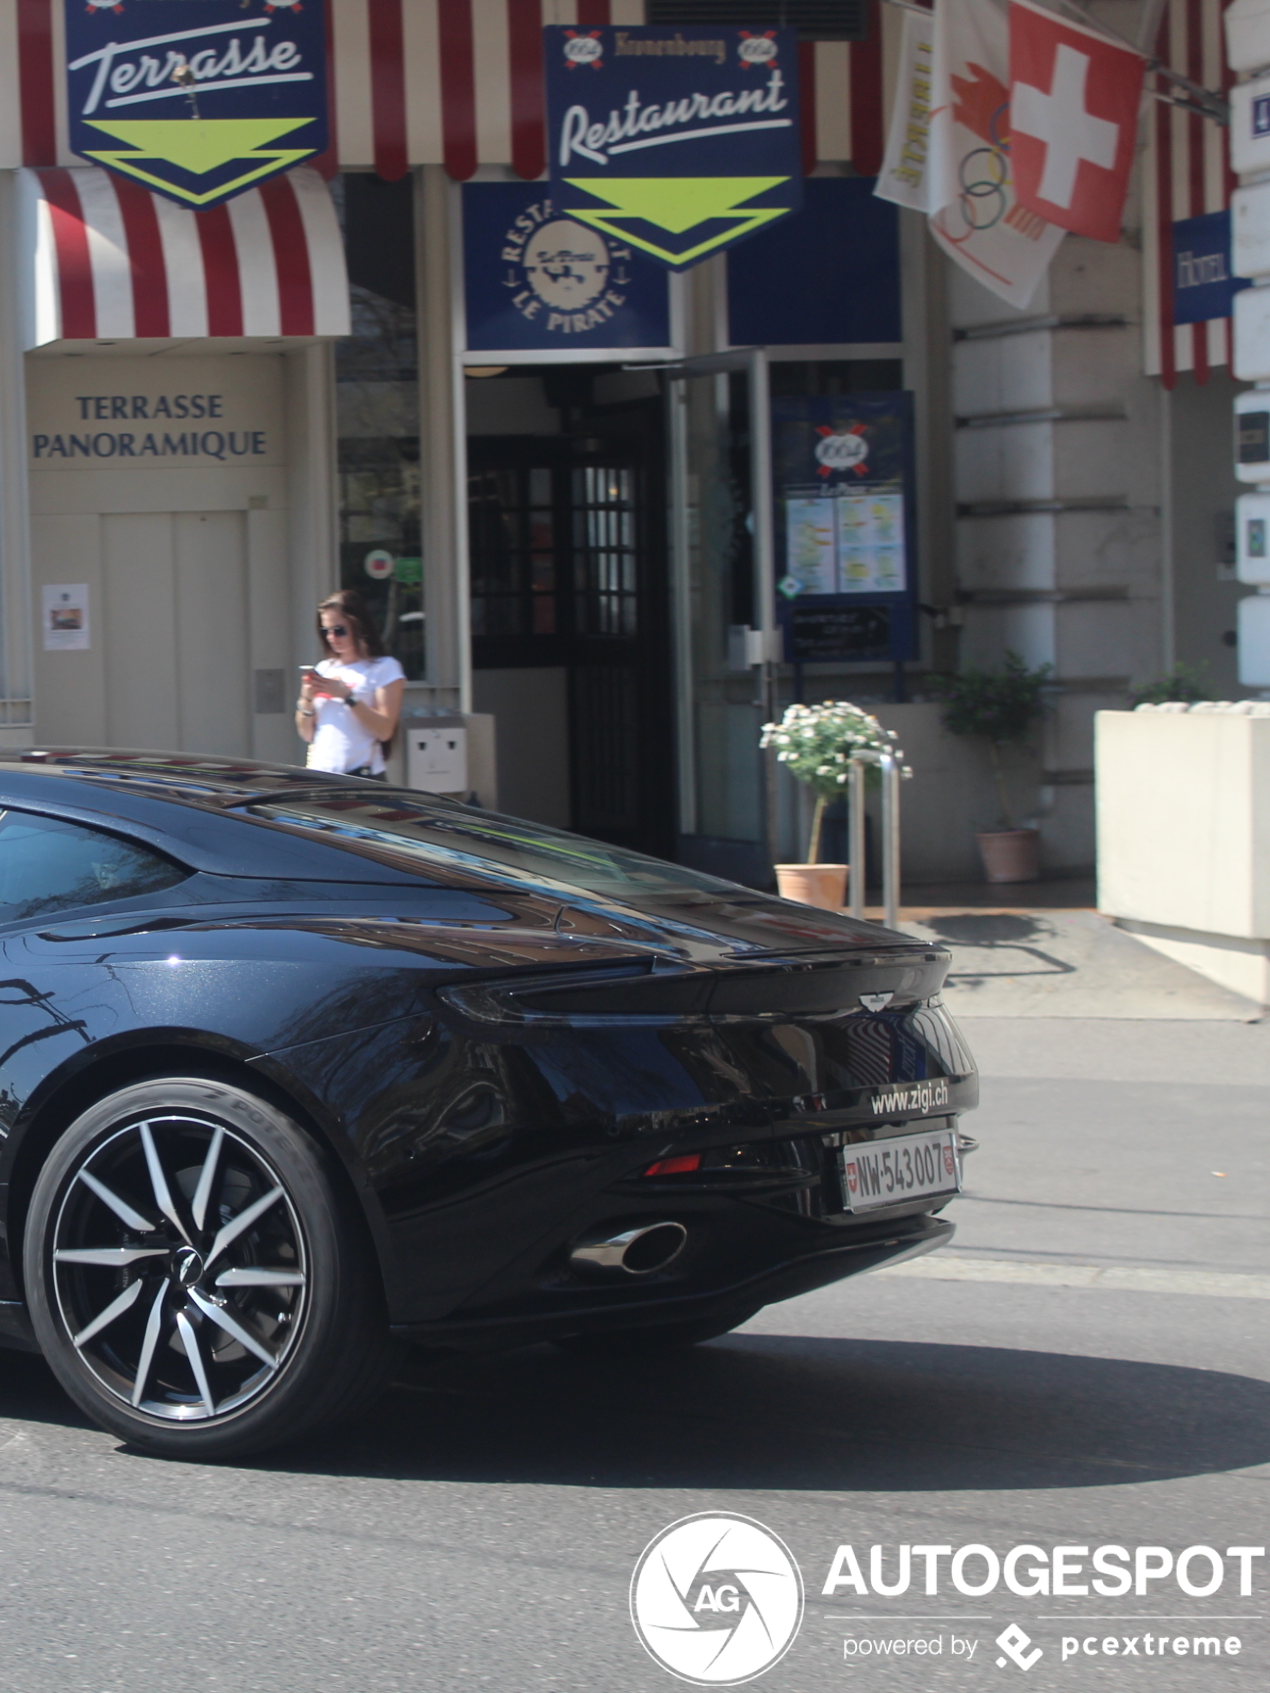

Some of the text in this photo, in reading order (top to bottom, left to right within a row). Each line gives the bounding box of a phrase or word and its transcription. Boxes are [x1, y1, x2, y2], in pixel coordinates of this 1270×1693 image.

[68, 17, 303, 114] Terrasse
[559, 69, 788, 166] Restaurant
[512, 289, 627, 334] LE PIRATE
[76, 394, 224, 420] TERRASSE
[32, 431, 267, 461] PANORAMIQUE
[871, 1080, 948, 1114] www.zigi.ch
